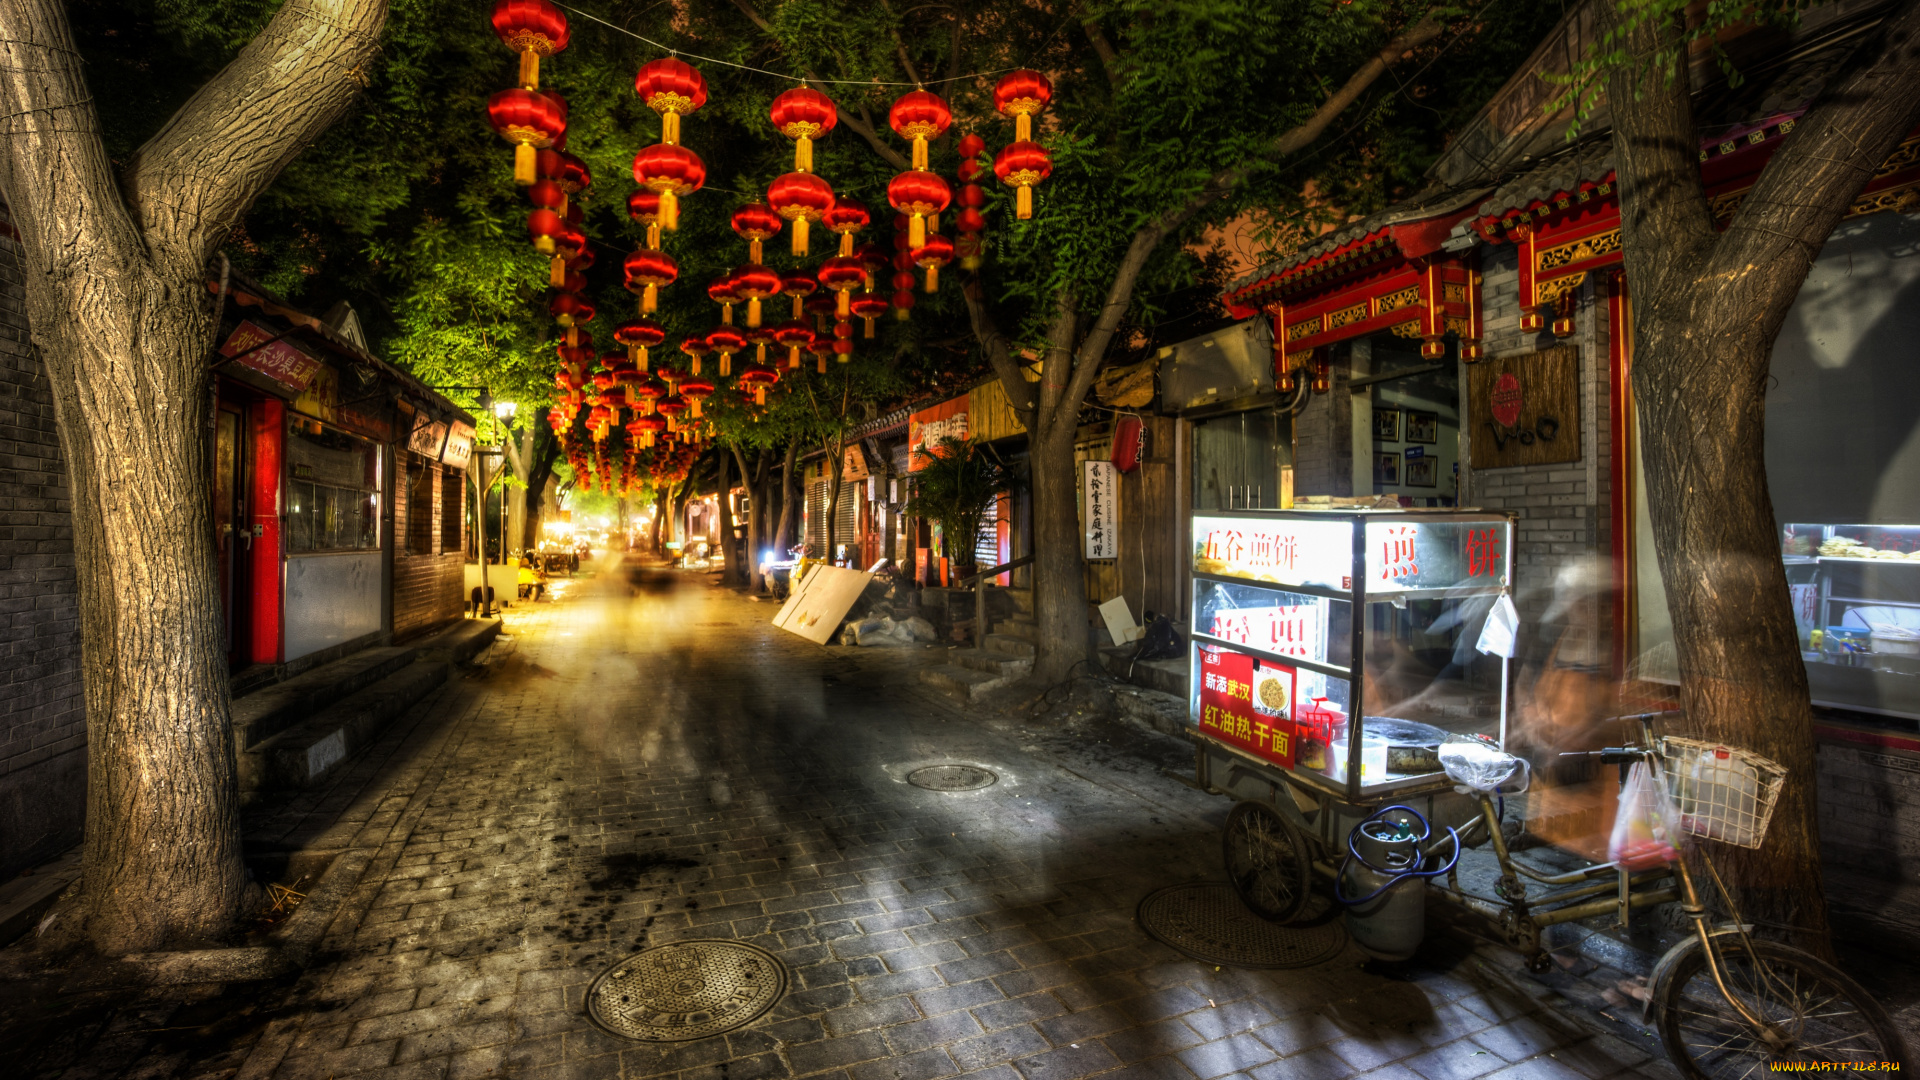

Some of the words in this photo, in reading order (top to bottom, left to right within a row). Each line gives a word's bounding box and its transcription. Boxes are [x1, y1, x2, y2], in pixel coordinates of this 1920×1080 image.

[1205, 529, 1299, 570] 五谷煎饼
[1205, 672, 1250, 702] 新添武汉
[1204, 704, 1289, 757] 红油热干面
